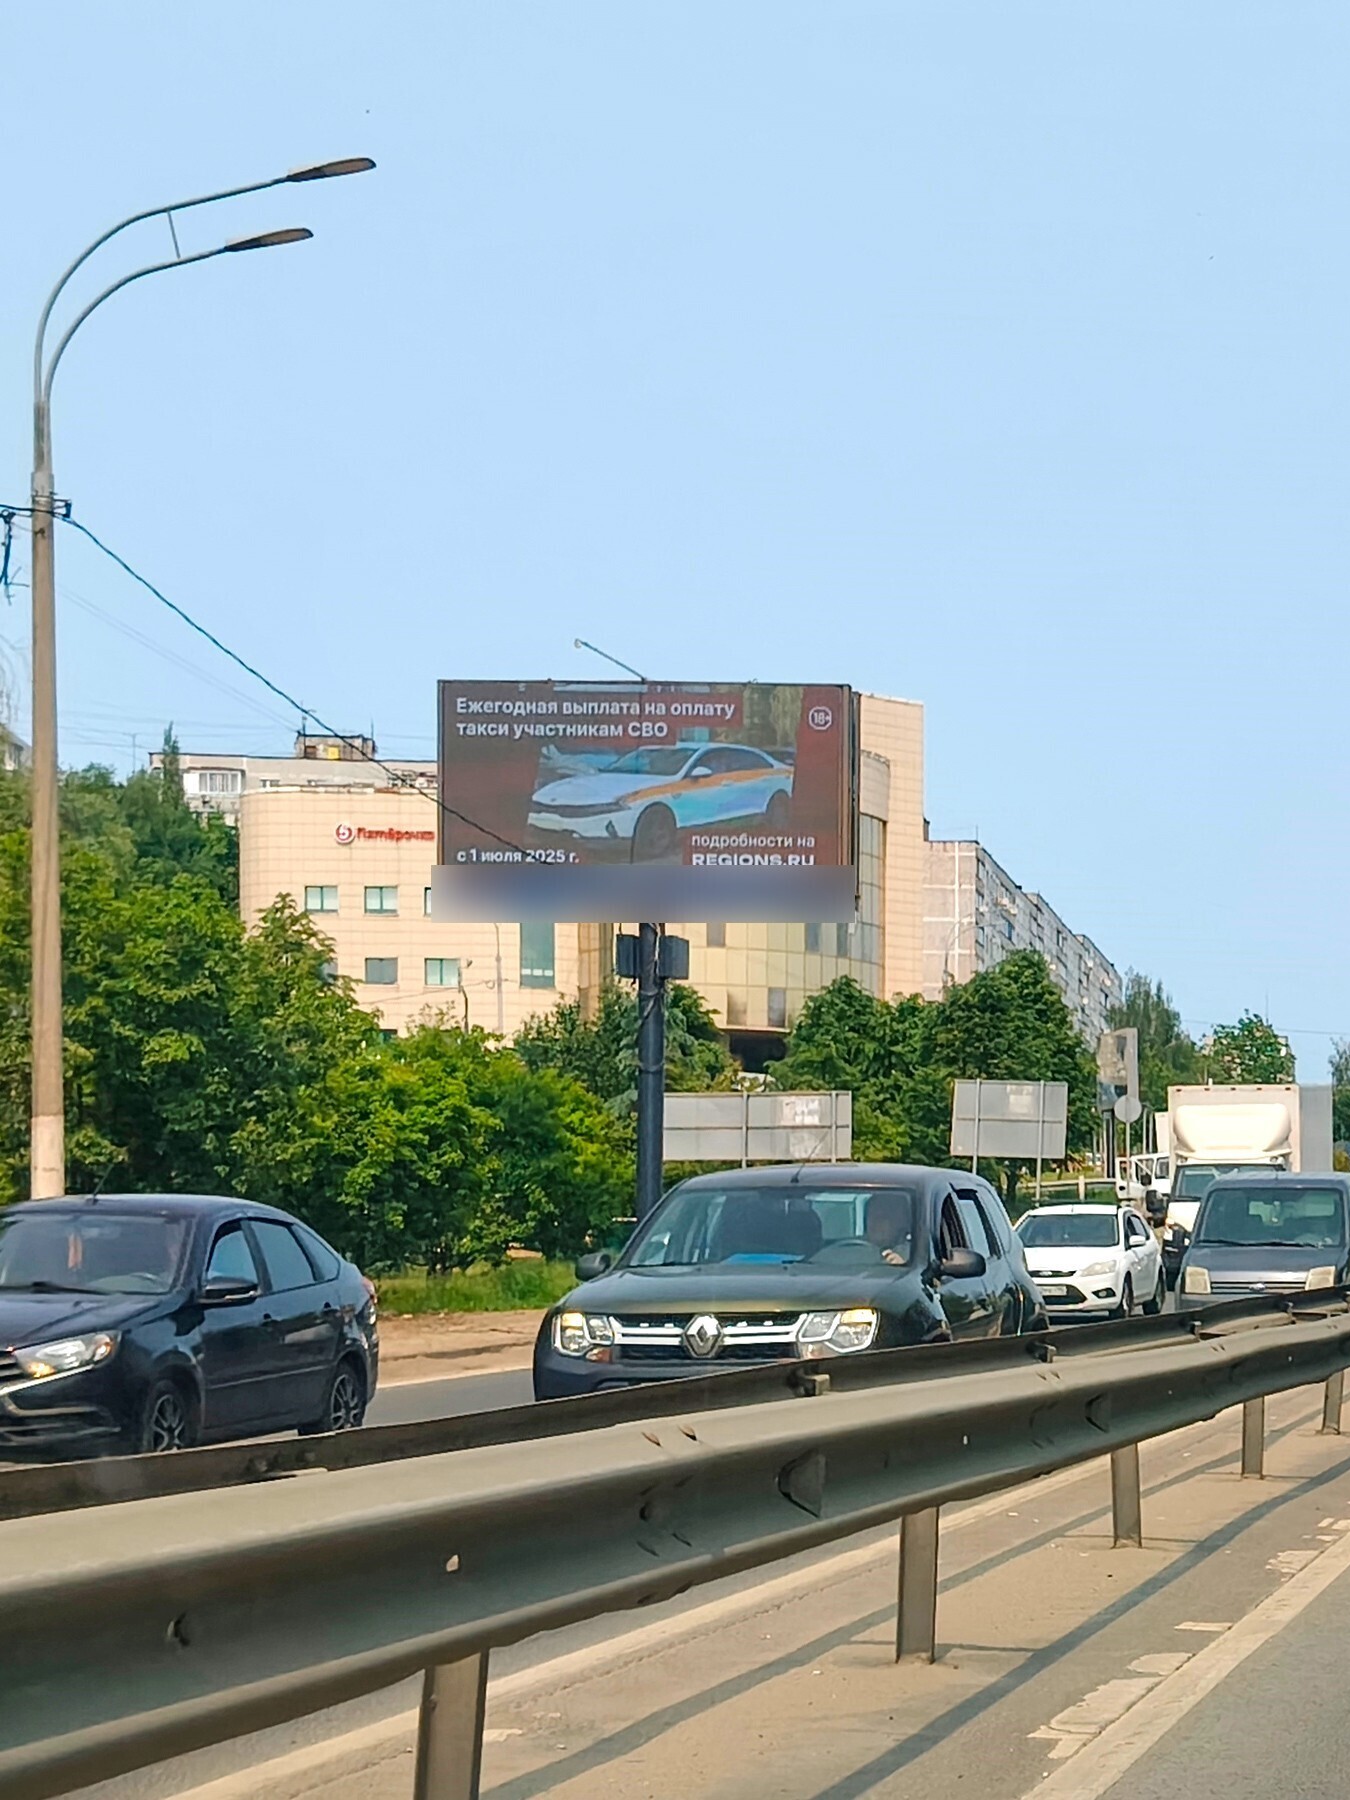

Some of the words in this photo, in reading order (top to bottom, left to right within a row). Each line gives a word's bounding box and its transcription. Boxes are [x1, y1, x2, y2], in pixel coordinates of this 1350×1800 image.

[456, 697, 558, 716] Ежегодная
[562, 701, 641, 715] выплата
[644, 702, 666, 716] на
[670, 703, 735, 720] оплату
[456, 723, 509, 736] такси
[513, 723, 623, 739] участникам
[627, 721, 668, 737] СВО
[691, 833, 793, 849] подробности
[797, 836, 815, 847] на
[457, 851, 466, 862] с
[469, 848, 477, 862] 1
[481, 851, 522, 862] июля
[525, 849, 565, 863] 2025
[569, 851, 580, 863] г.
[692, 853, 815, 866] REGIONS.RU
